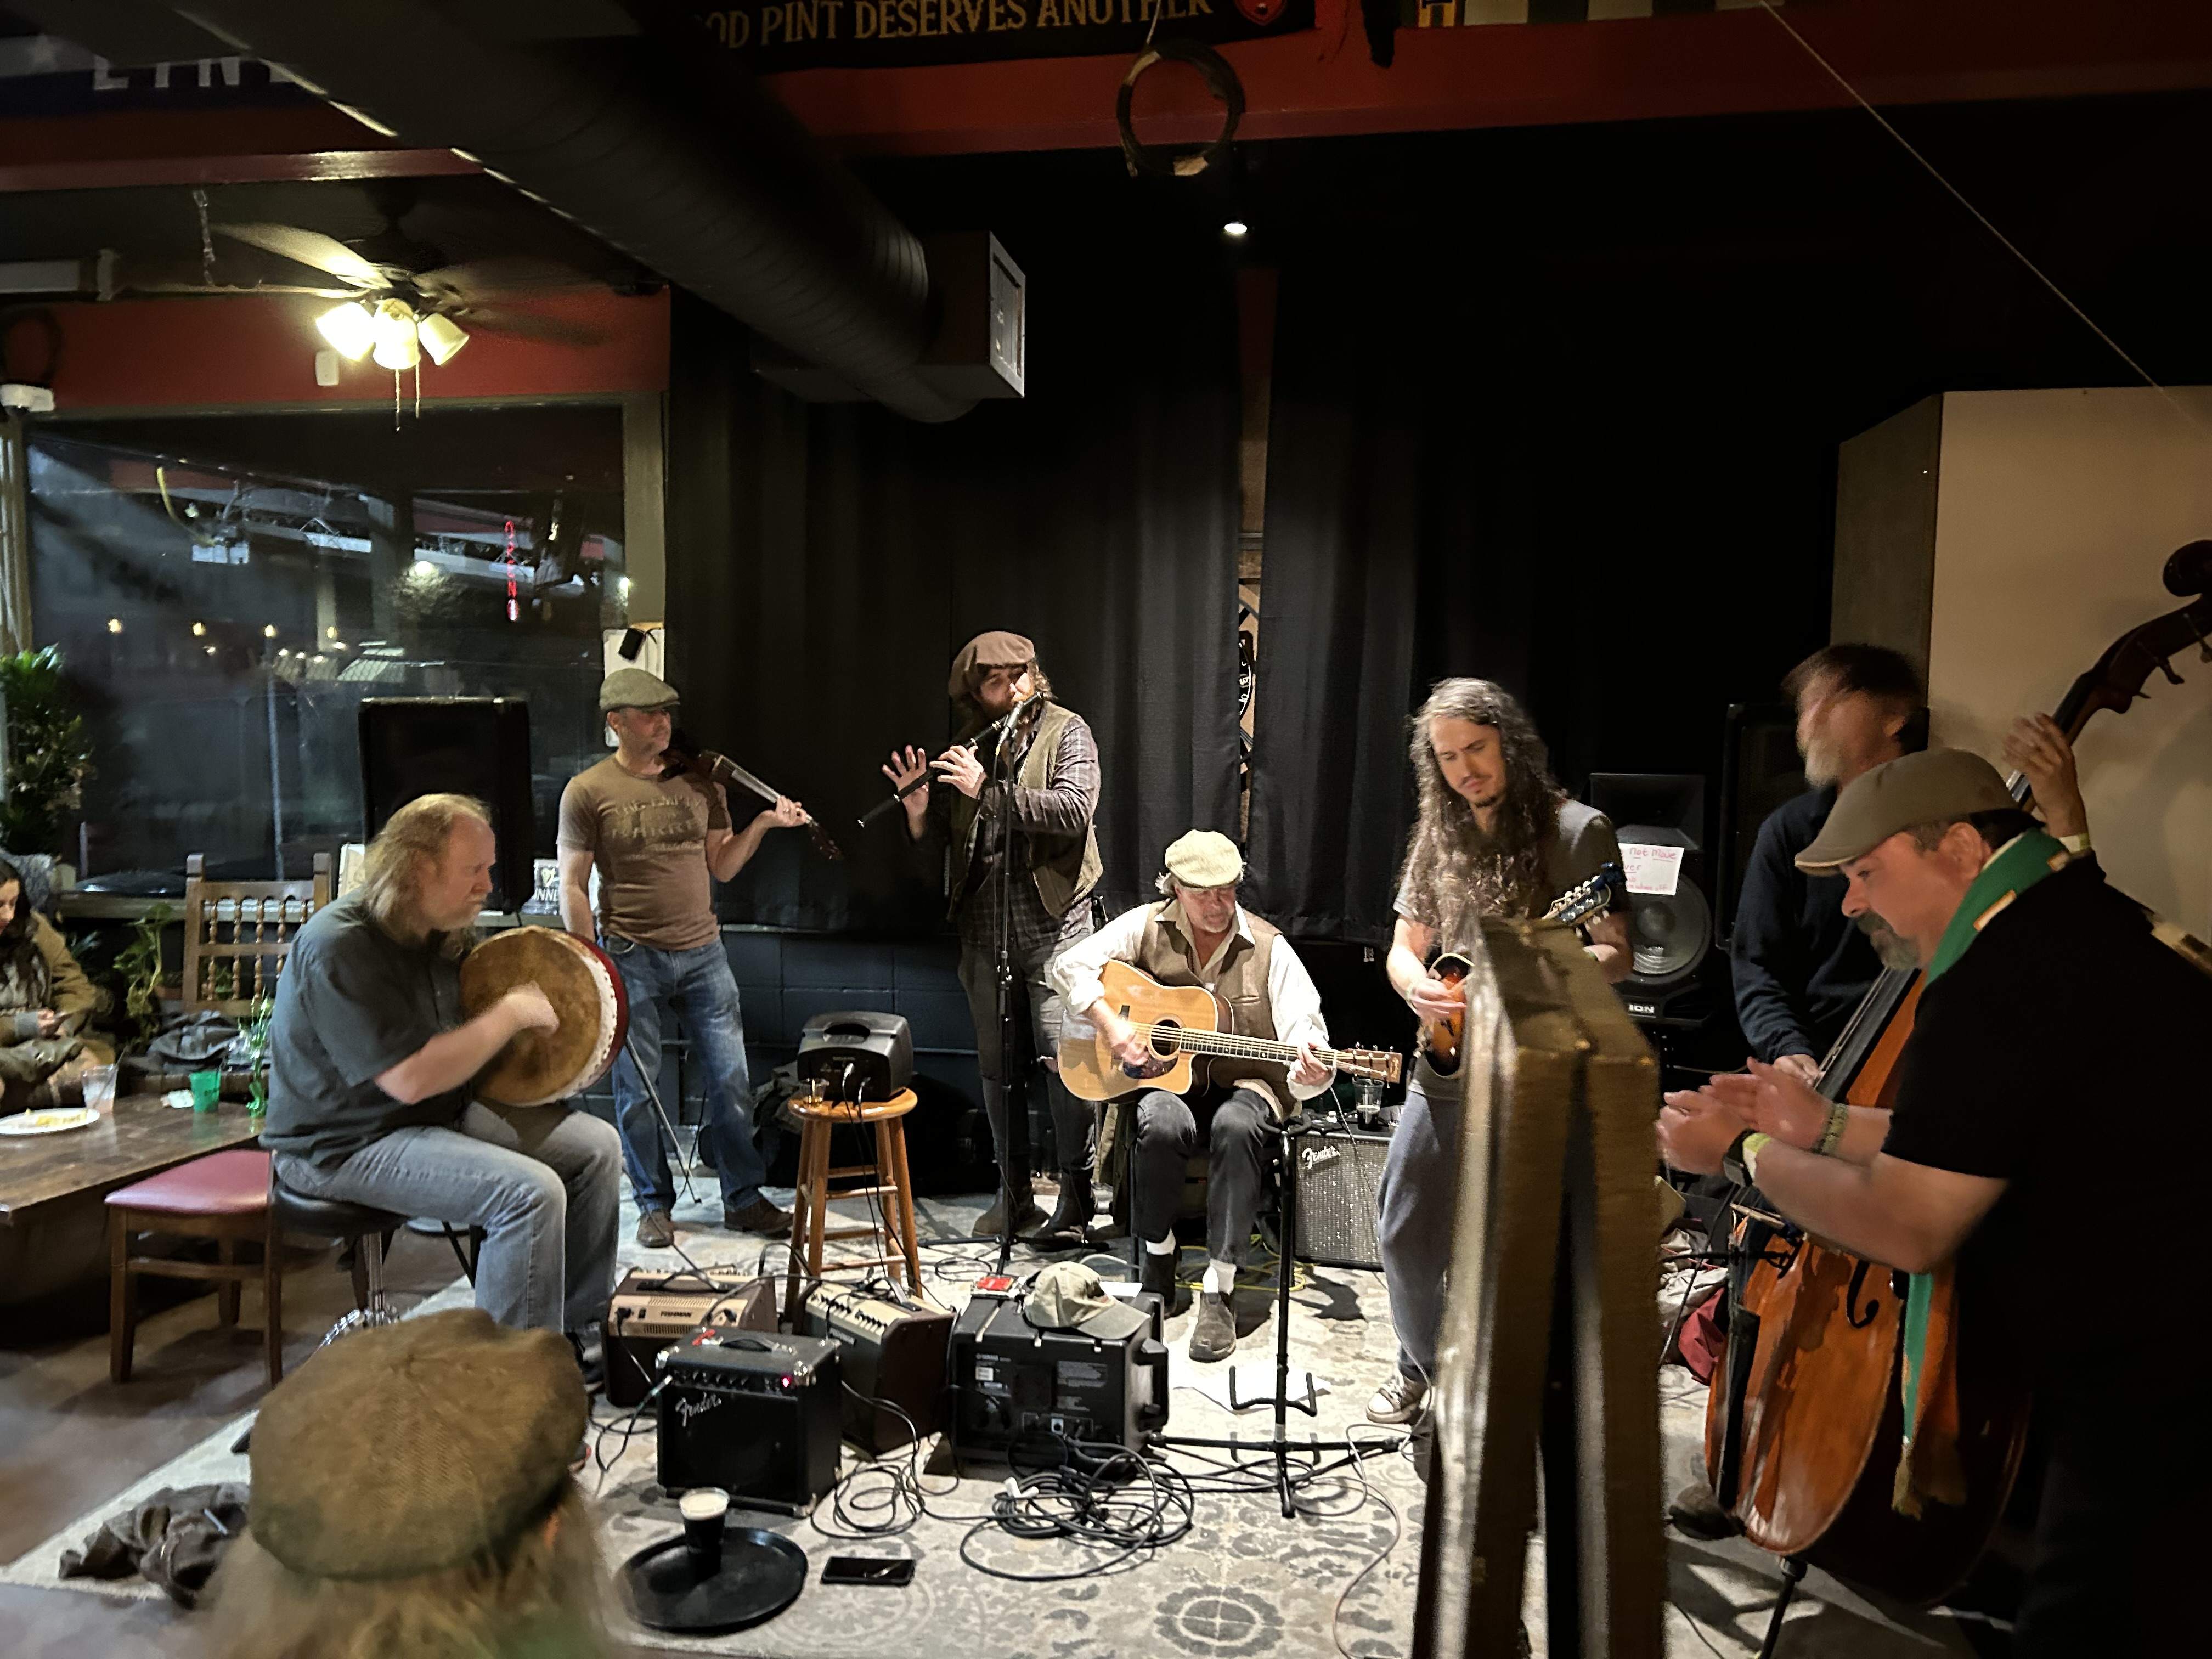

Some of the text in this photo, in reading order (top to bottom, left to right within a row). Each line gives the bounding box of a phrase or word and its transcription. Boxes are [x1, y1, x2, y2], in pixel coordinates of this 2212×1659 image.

[704, 10, 751, 49] OD
[760, 1, 843, 47] PINT
[854, 0, 1027, 40] DESERVES
[1301, 1146, 1340, 1169] Fender
[675, 1392, 722, 1427] Fender
